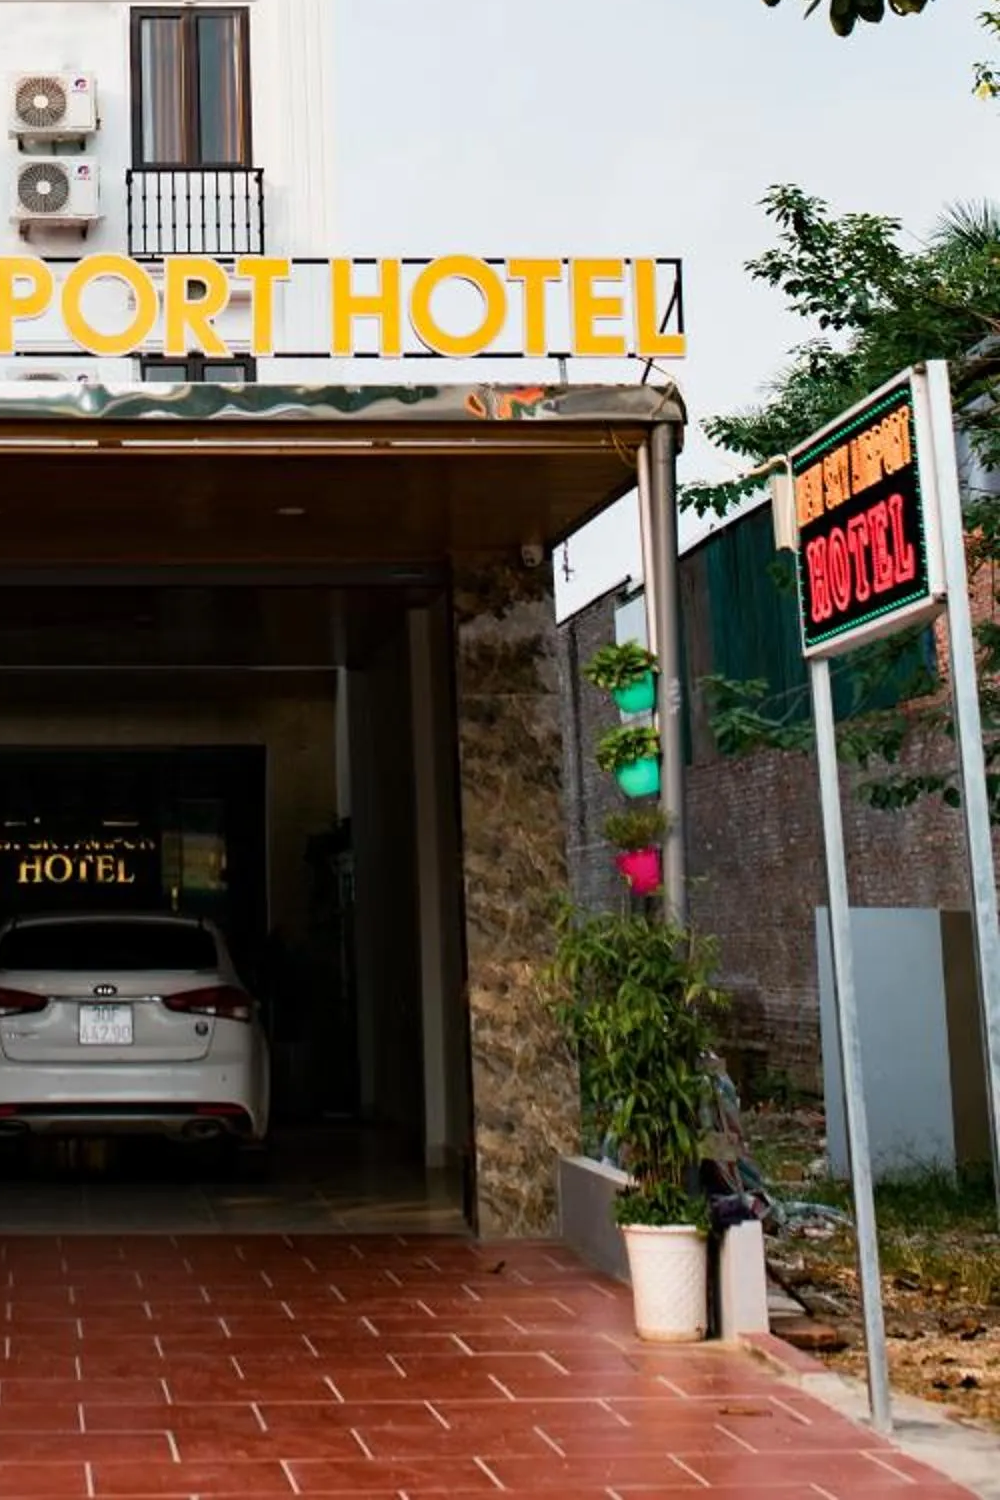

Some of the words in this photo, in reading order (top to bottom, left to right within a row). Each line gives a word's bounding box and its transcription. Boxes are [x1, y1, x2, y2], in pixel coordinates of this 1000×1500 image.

[330, 253, 687, 358] HOTEL
[806, 494, 914, 623] HOTEL
[16, 853, 136, 884] HOTEL
